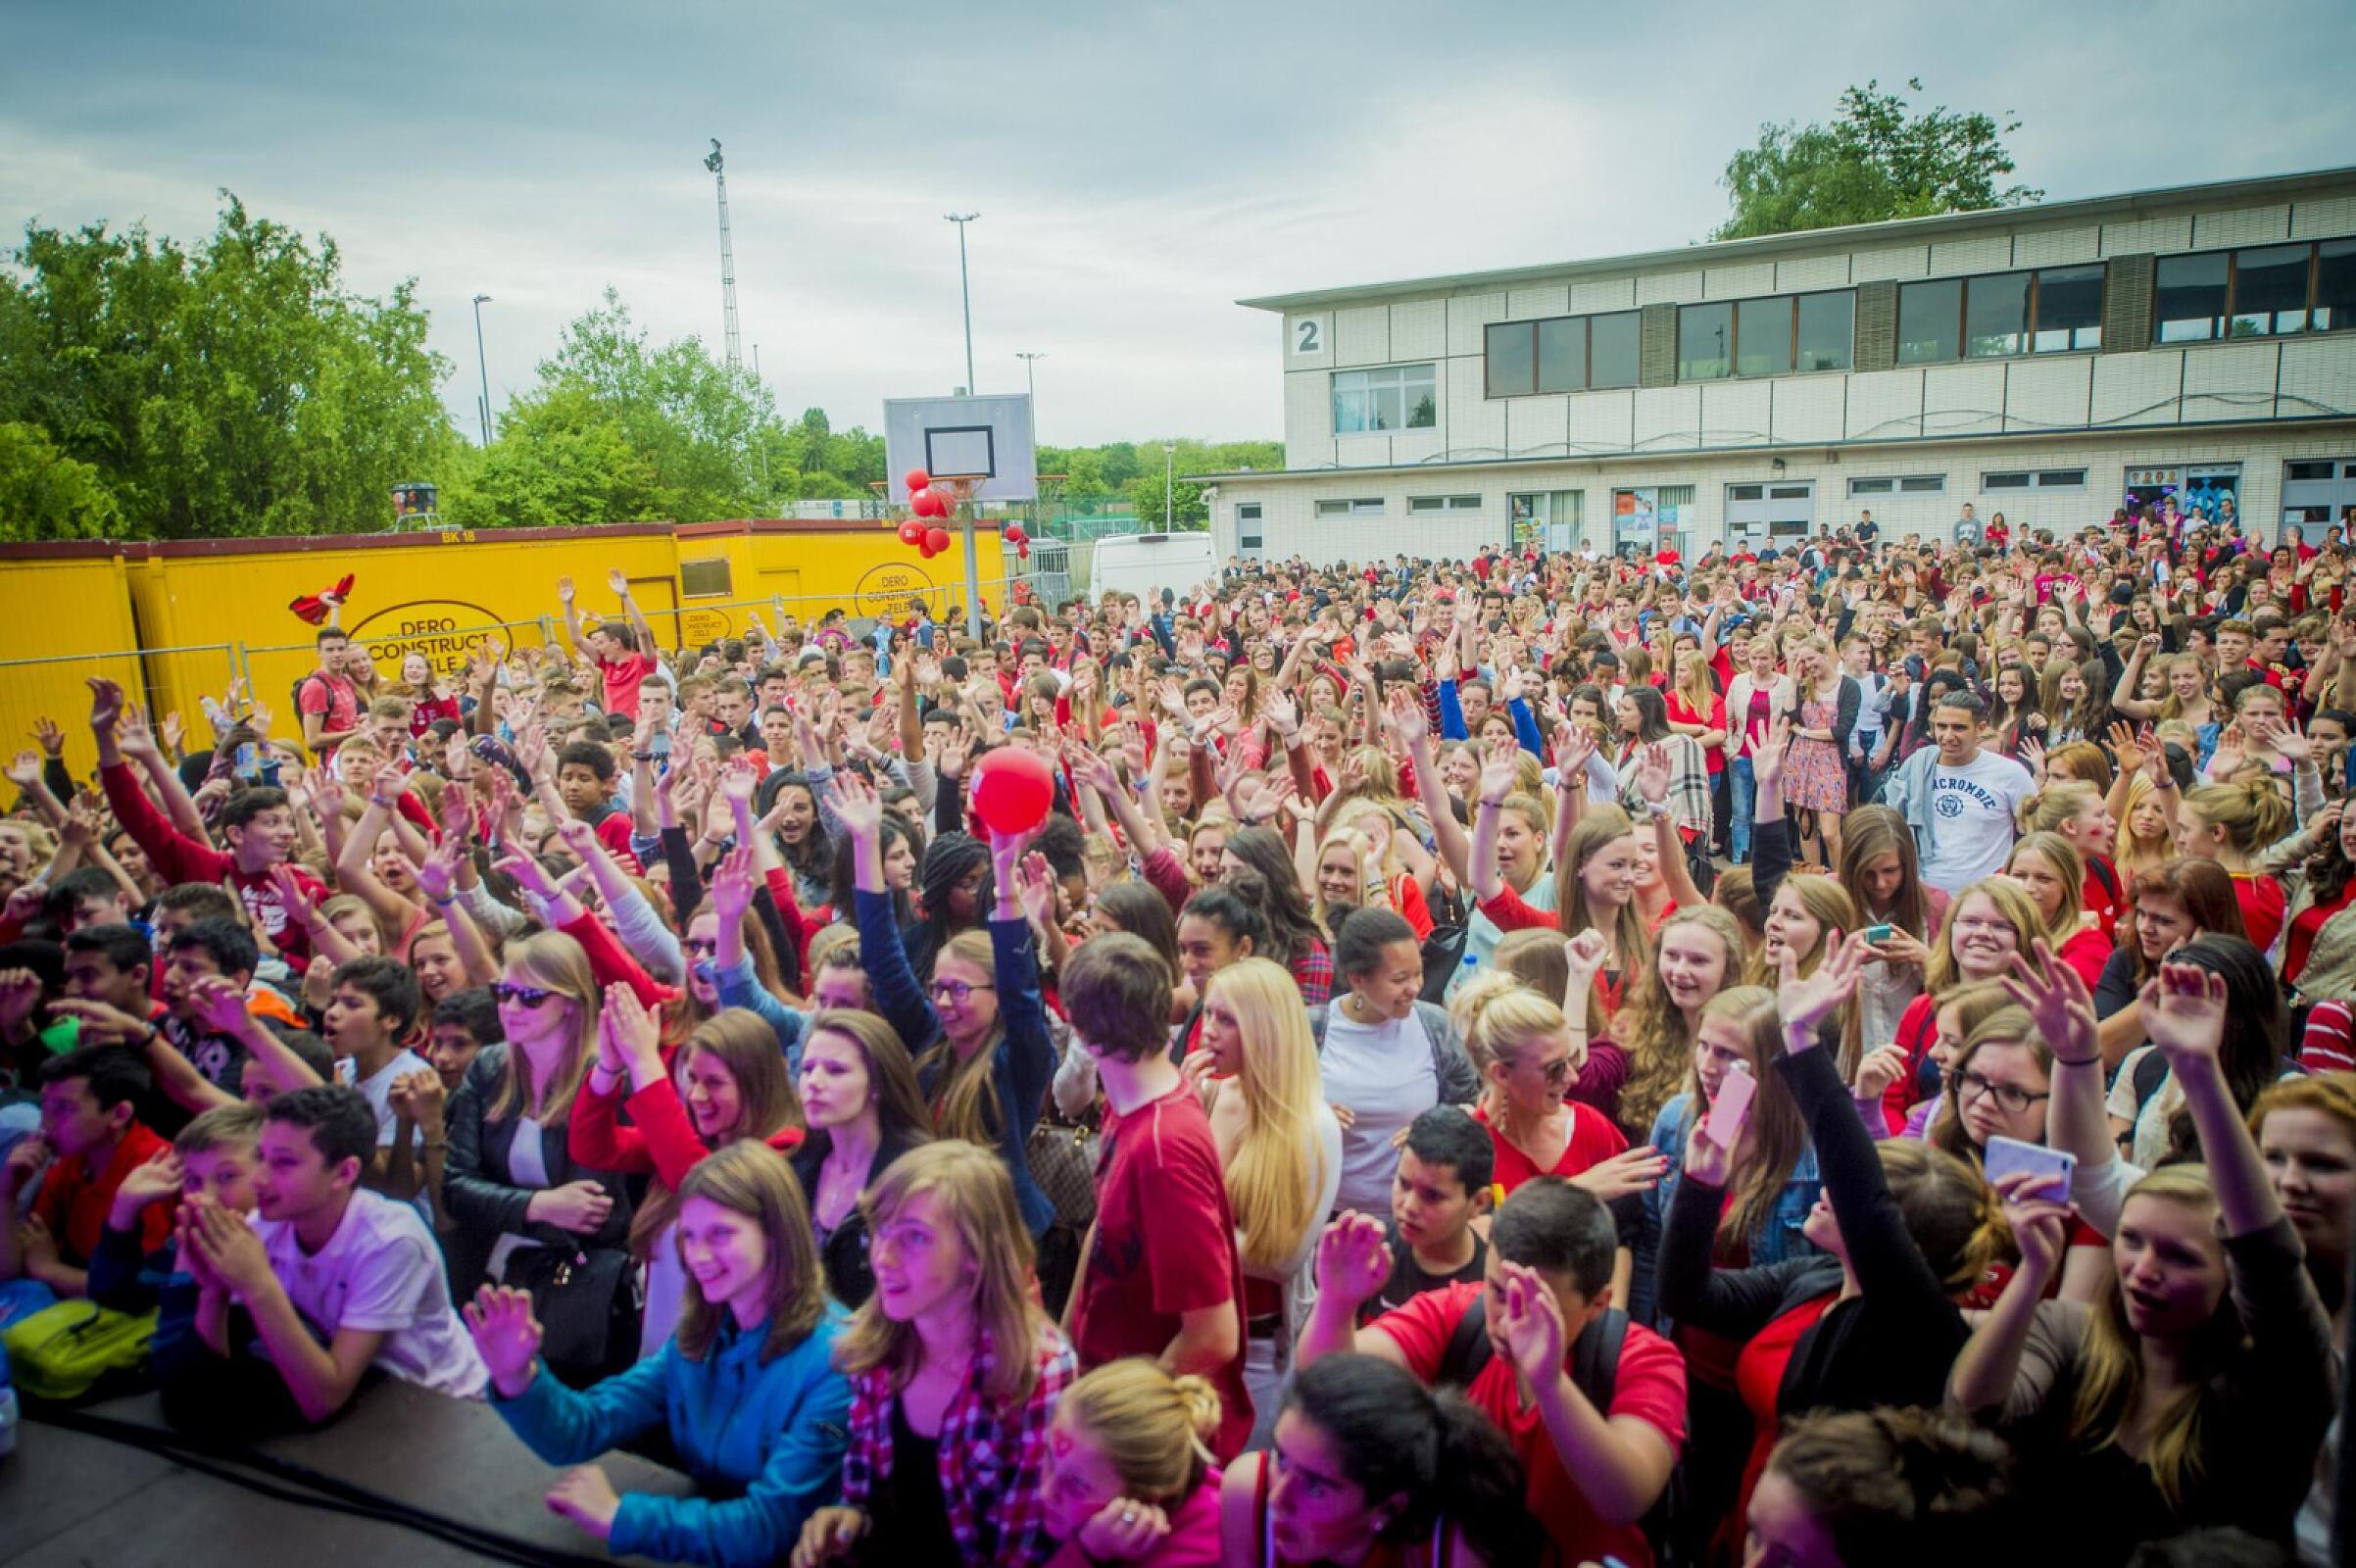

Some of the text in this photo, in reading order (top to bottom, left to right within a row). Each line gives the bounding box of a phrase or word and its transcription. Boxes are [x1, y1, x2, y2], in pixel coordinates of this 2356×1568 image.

[1298, 319, 1319, 352] 2
[441, 531, 461, 543] BK
[882, 575, 908, 588] DERO
[400, 617, 457, 638] DERO
[368, 632, 489, 662] CONSTRUCT
